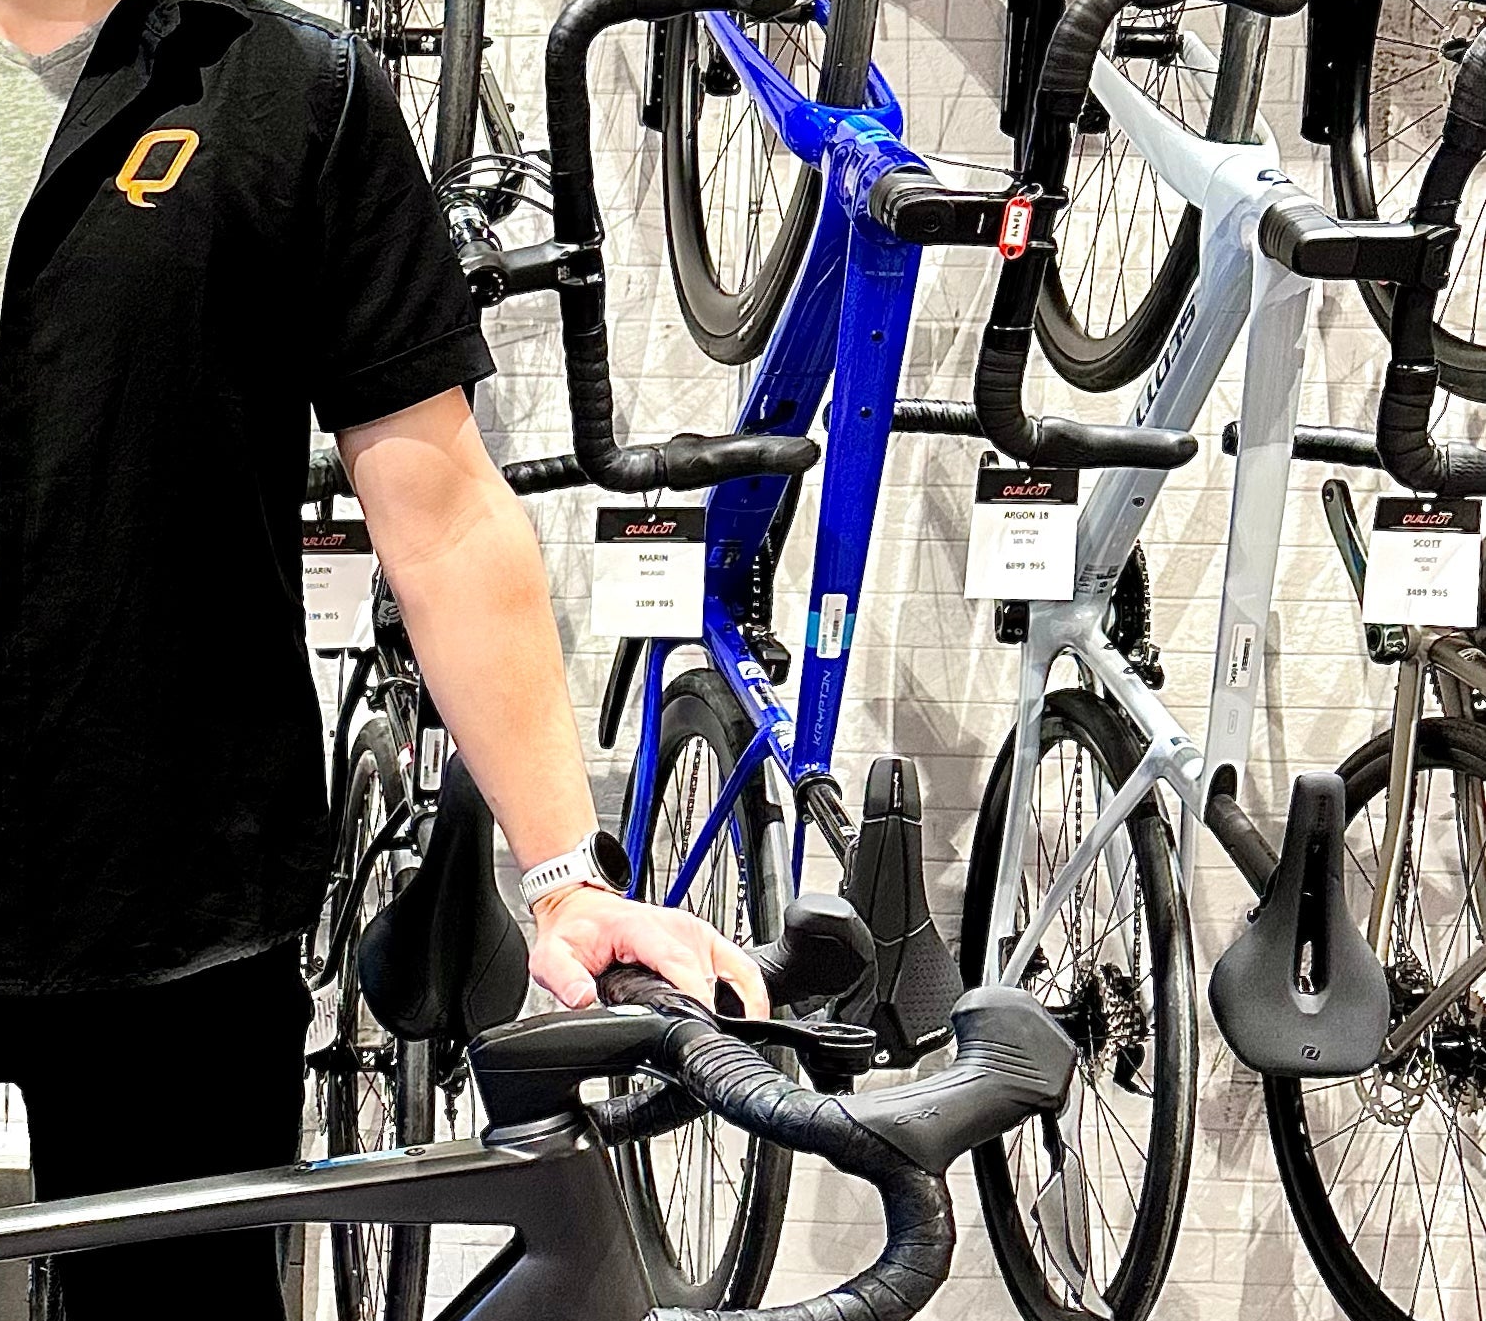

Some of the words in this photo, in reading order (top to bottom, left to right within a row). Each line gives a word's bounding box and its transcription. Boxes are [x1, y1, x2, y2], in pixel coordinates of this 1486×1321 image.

[115, 128, 200, 209] Q
[1003, 485, 1052, 497] QUILICOT
[1004, 511, 1035, 520] ARGON
[1038, 511, 1050, 519] 18
[1402, 513, 1453, 525] QUILICOT
[625, 523, 677, 536] QUILICOT
[1413, 539, 1442, 548] SCOTT
[639, 554, 669, 563] MARIN
[304, 567, 332, 575] MARIN
[812, 669, 832, 746] KRYPTON
